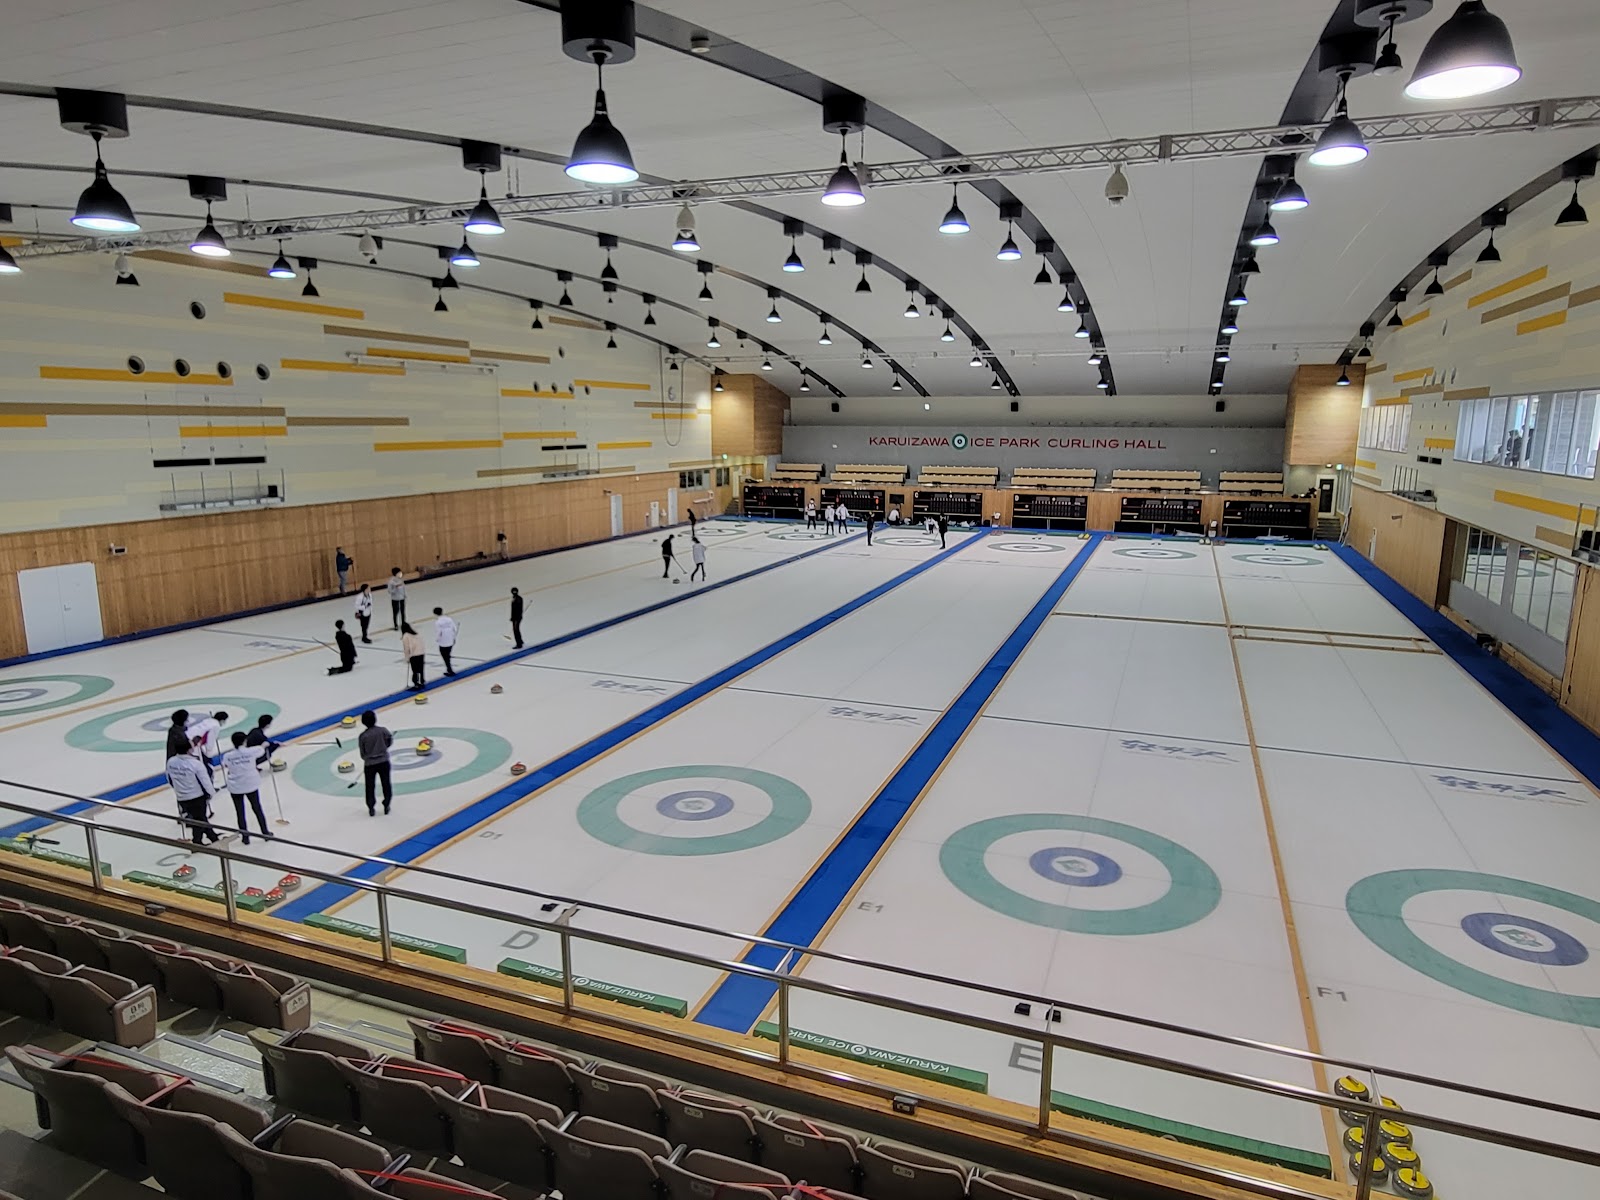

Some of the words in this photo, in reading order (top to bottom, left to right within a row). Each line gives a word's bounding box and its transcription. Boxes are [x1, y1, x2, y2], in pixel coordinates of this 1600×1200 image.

[869, 436, 950, 447] KARUIZAWA
[970, 437, 995, 447] ICE
[999, 437, 1040, 448] PARK
[1047, 438, 1120, 449] CURLING
[1124, 439, 1167, 449] HALL
[479, 830, 504, 840] D1
[857, 901, 885, 913] E1
[501, 929, 540, 950] D
[525, 964, 558, 978] PARK
[589, 980, 656, 1002] KARUIZAWA
[1316, 986, 1348, 1002] F1
[788, 1028, 825, 1044] PARK
[827, 1038, 851, 1052] ICE
[867, 1048, 951, 1073] KARUIZAWA
[1008, 1042, 1043, 1074] E
